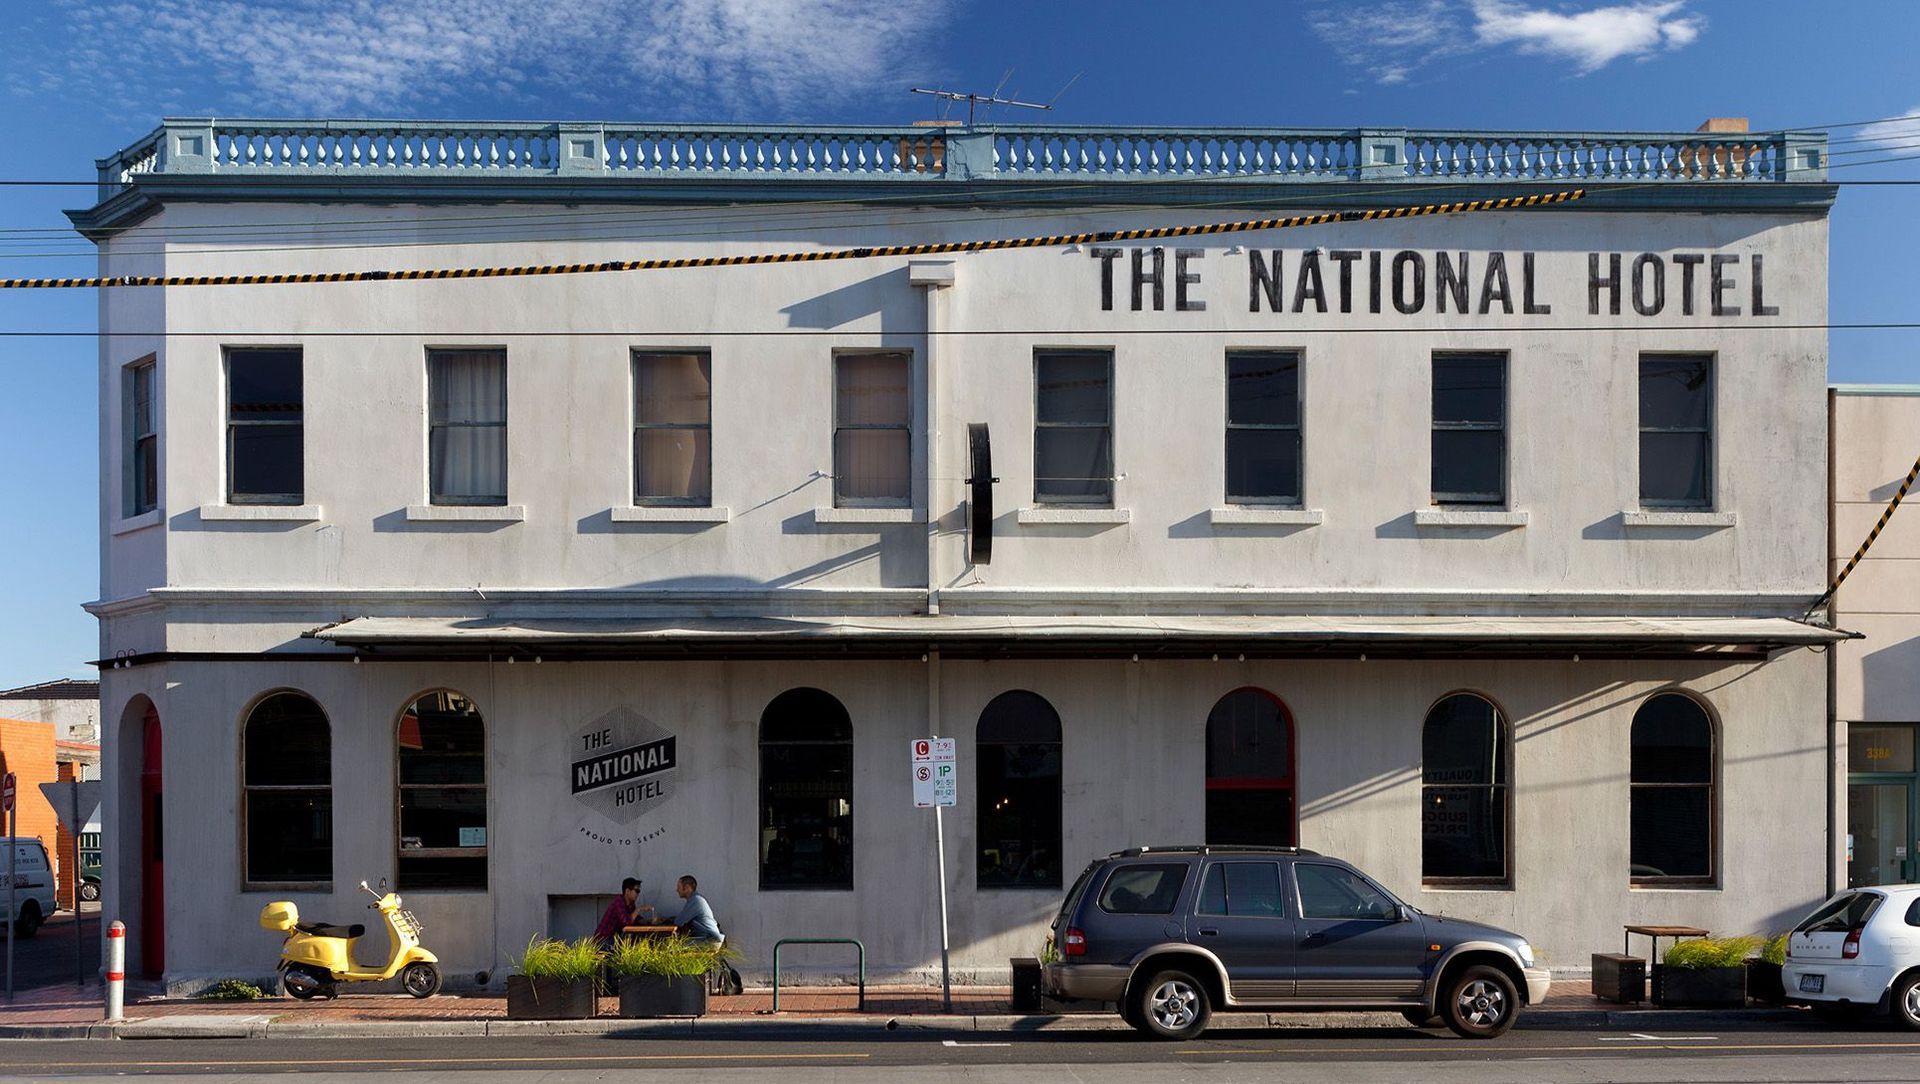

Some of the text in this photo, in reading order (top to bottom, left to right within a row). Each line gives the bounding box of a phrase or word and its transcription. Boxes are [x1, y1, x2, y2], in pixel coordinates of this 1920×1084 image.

[1091, 247, 1779, 317] THE NATIONAL HOTEL
[582, 728, 612, 751] THE
[577, 745, 670, 787] NATIONAL
[938, 766, 951, 777] 1P
[615, 780, 664, 807] HOTEL
[580, 827, 613, 845] PROUD
[637, 827, 666, 844] SERVE
